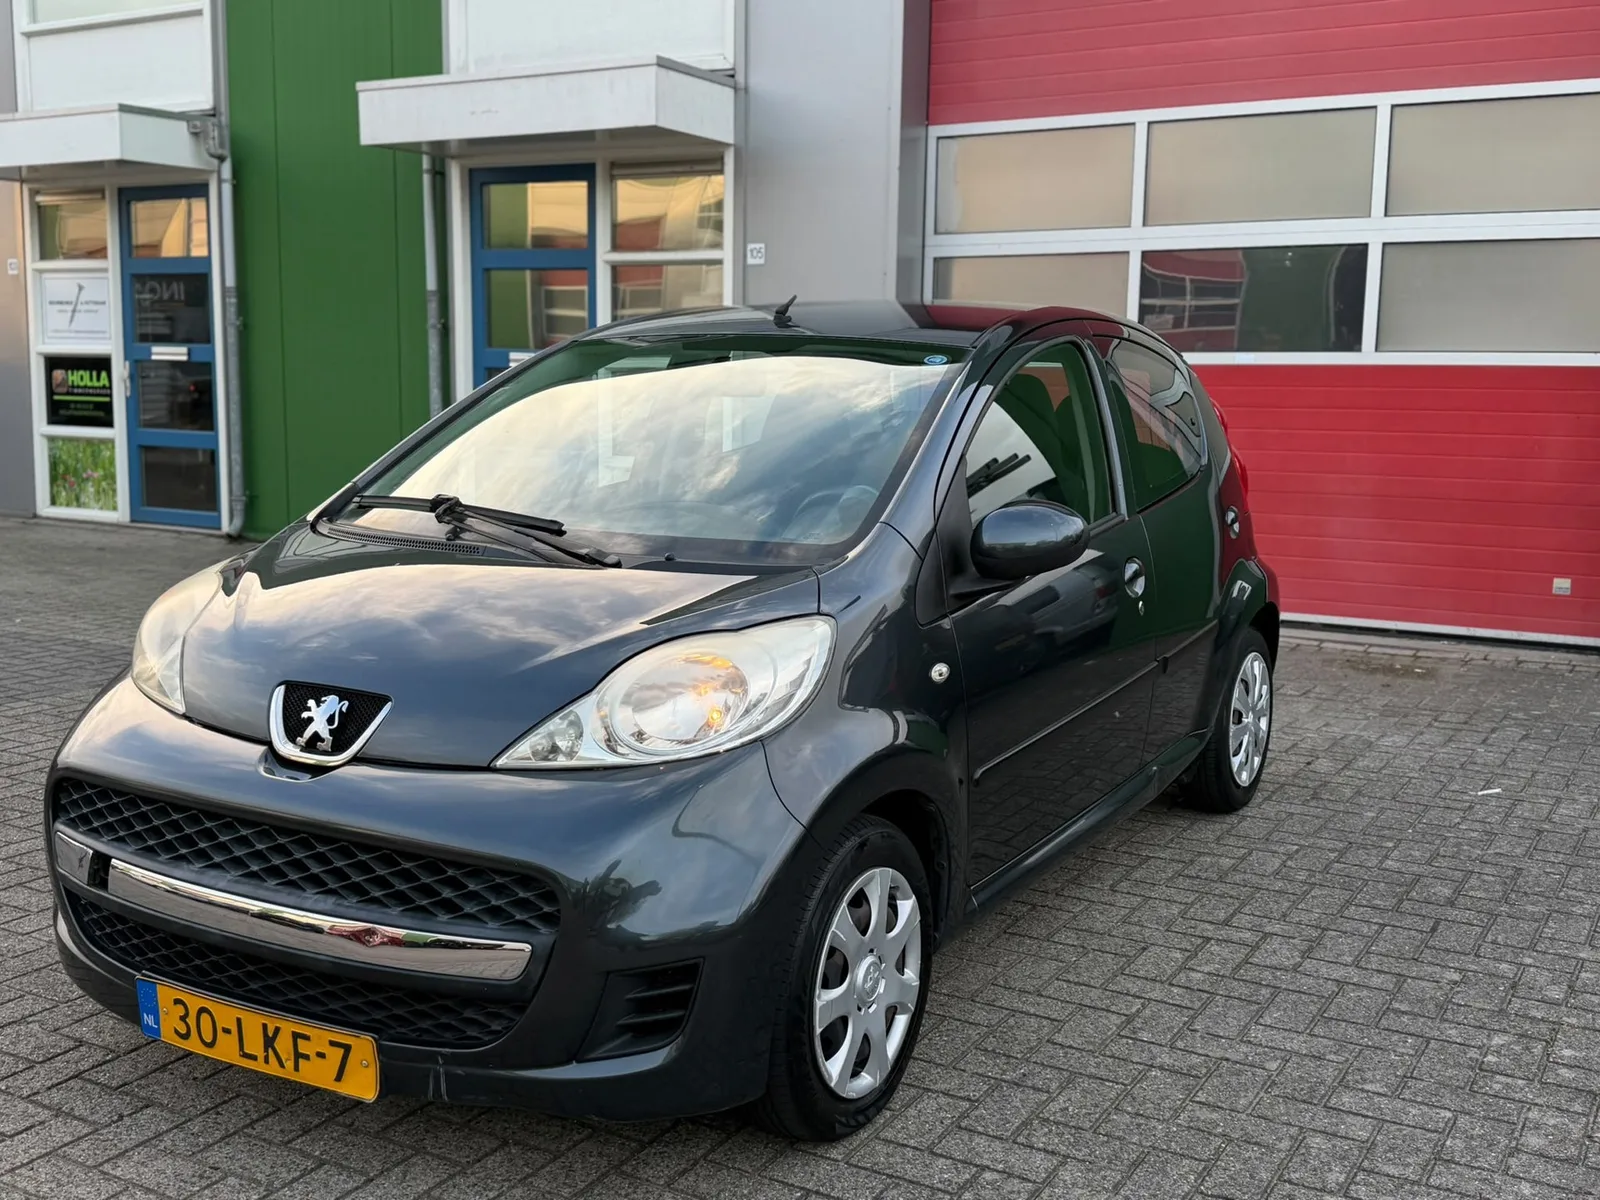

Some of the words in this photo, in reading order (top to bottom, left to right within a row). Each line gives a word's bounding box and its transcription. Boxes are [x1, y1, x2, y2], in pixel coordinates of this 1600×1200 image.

[67, 369, 110, 388] HOLLA
[143, 1014, 159, 1029] NL
[172, 997, 353, 1083] 30-LKF-7
